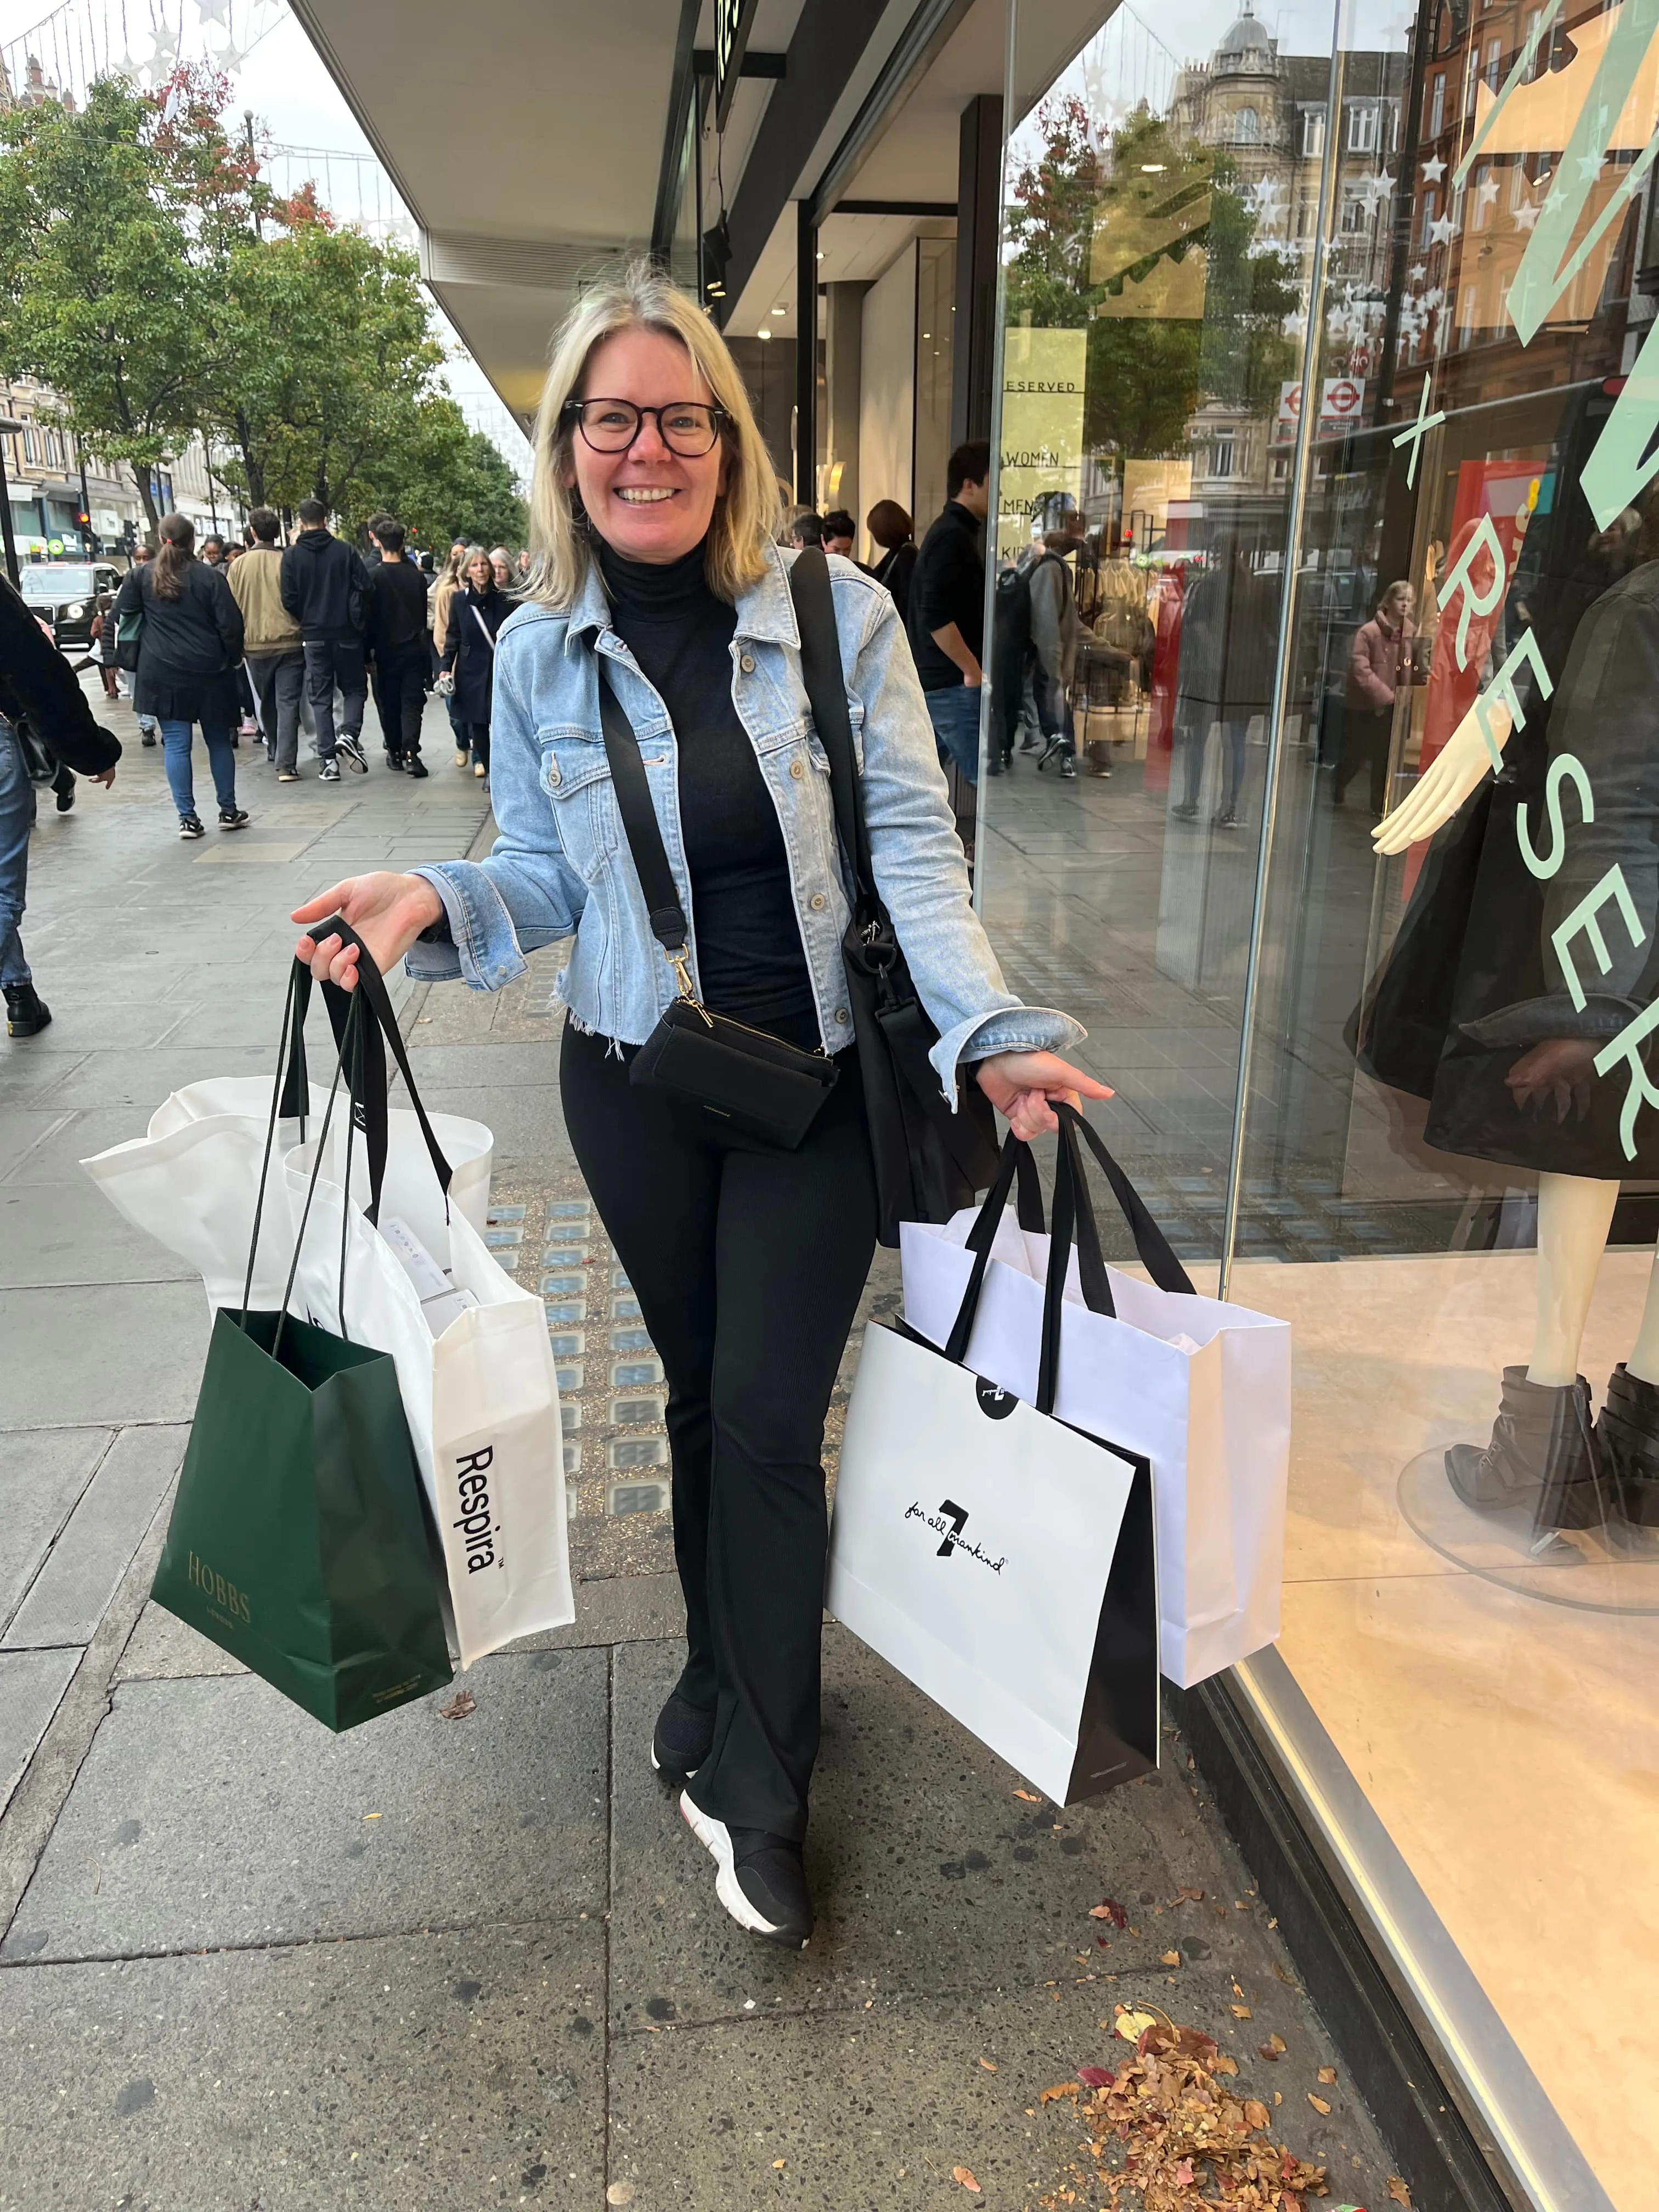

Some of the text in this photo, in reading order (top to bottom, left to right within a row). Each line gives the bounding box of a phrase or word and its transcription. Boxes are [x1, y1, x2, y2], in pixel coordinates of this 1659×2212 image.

[1006, 452, 1059, 466] WOMEN
[904, 1502, 1005, 1576] for all mankind
[188, 1550, 251, 1623] HOBBS
